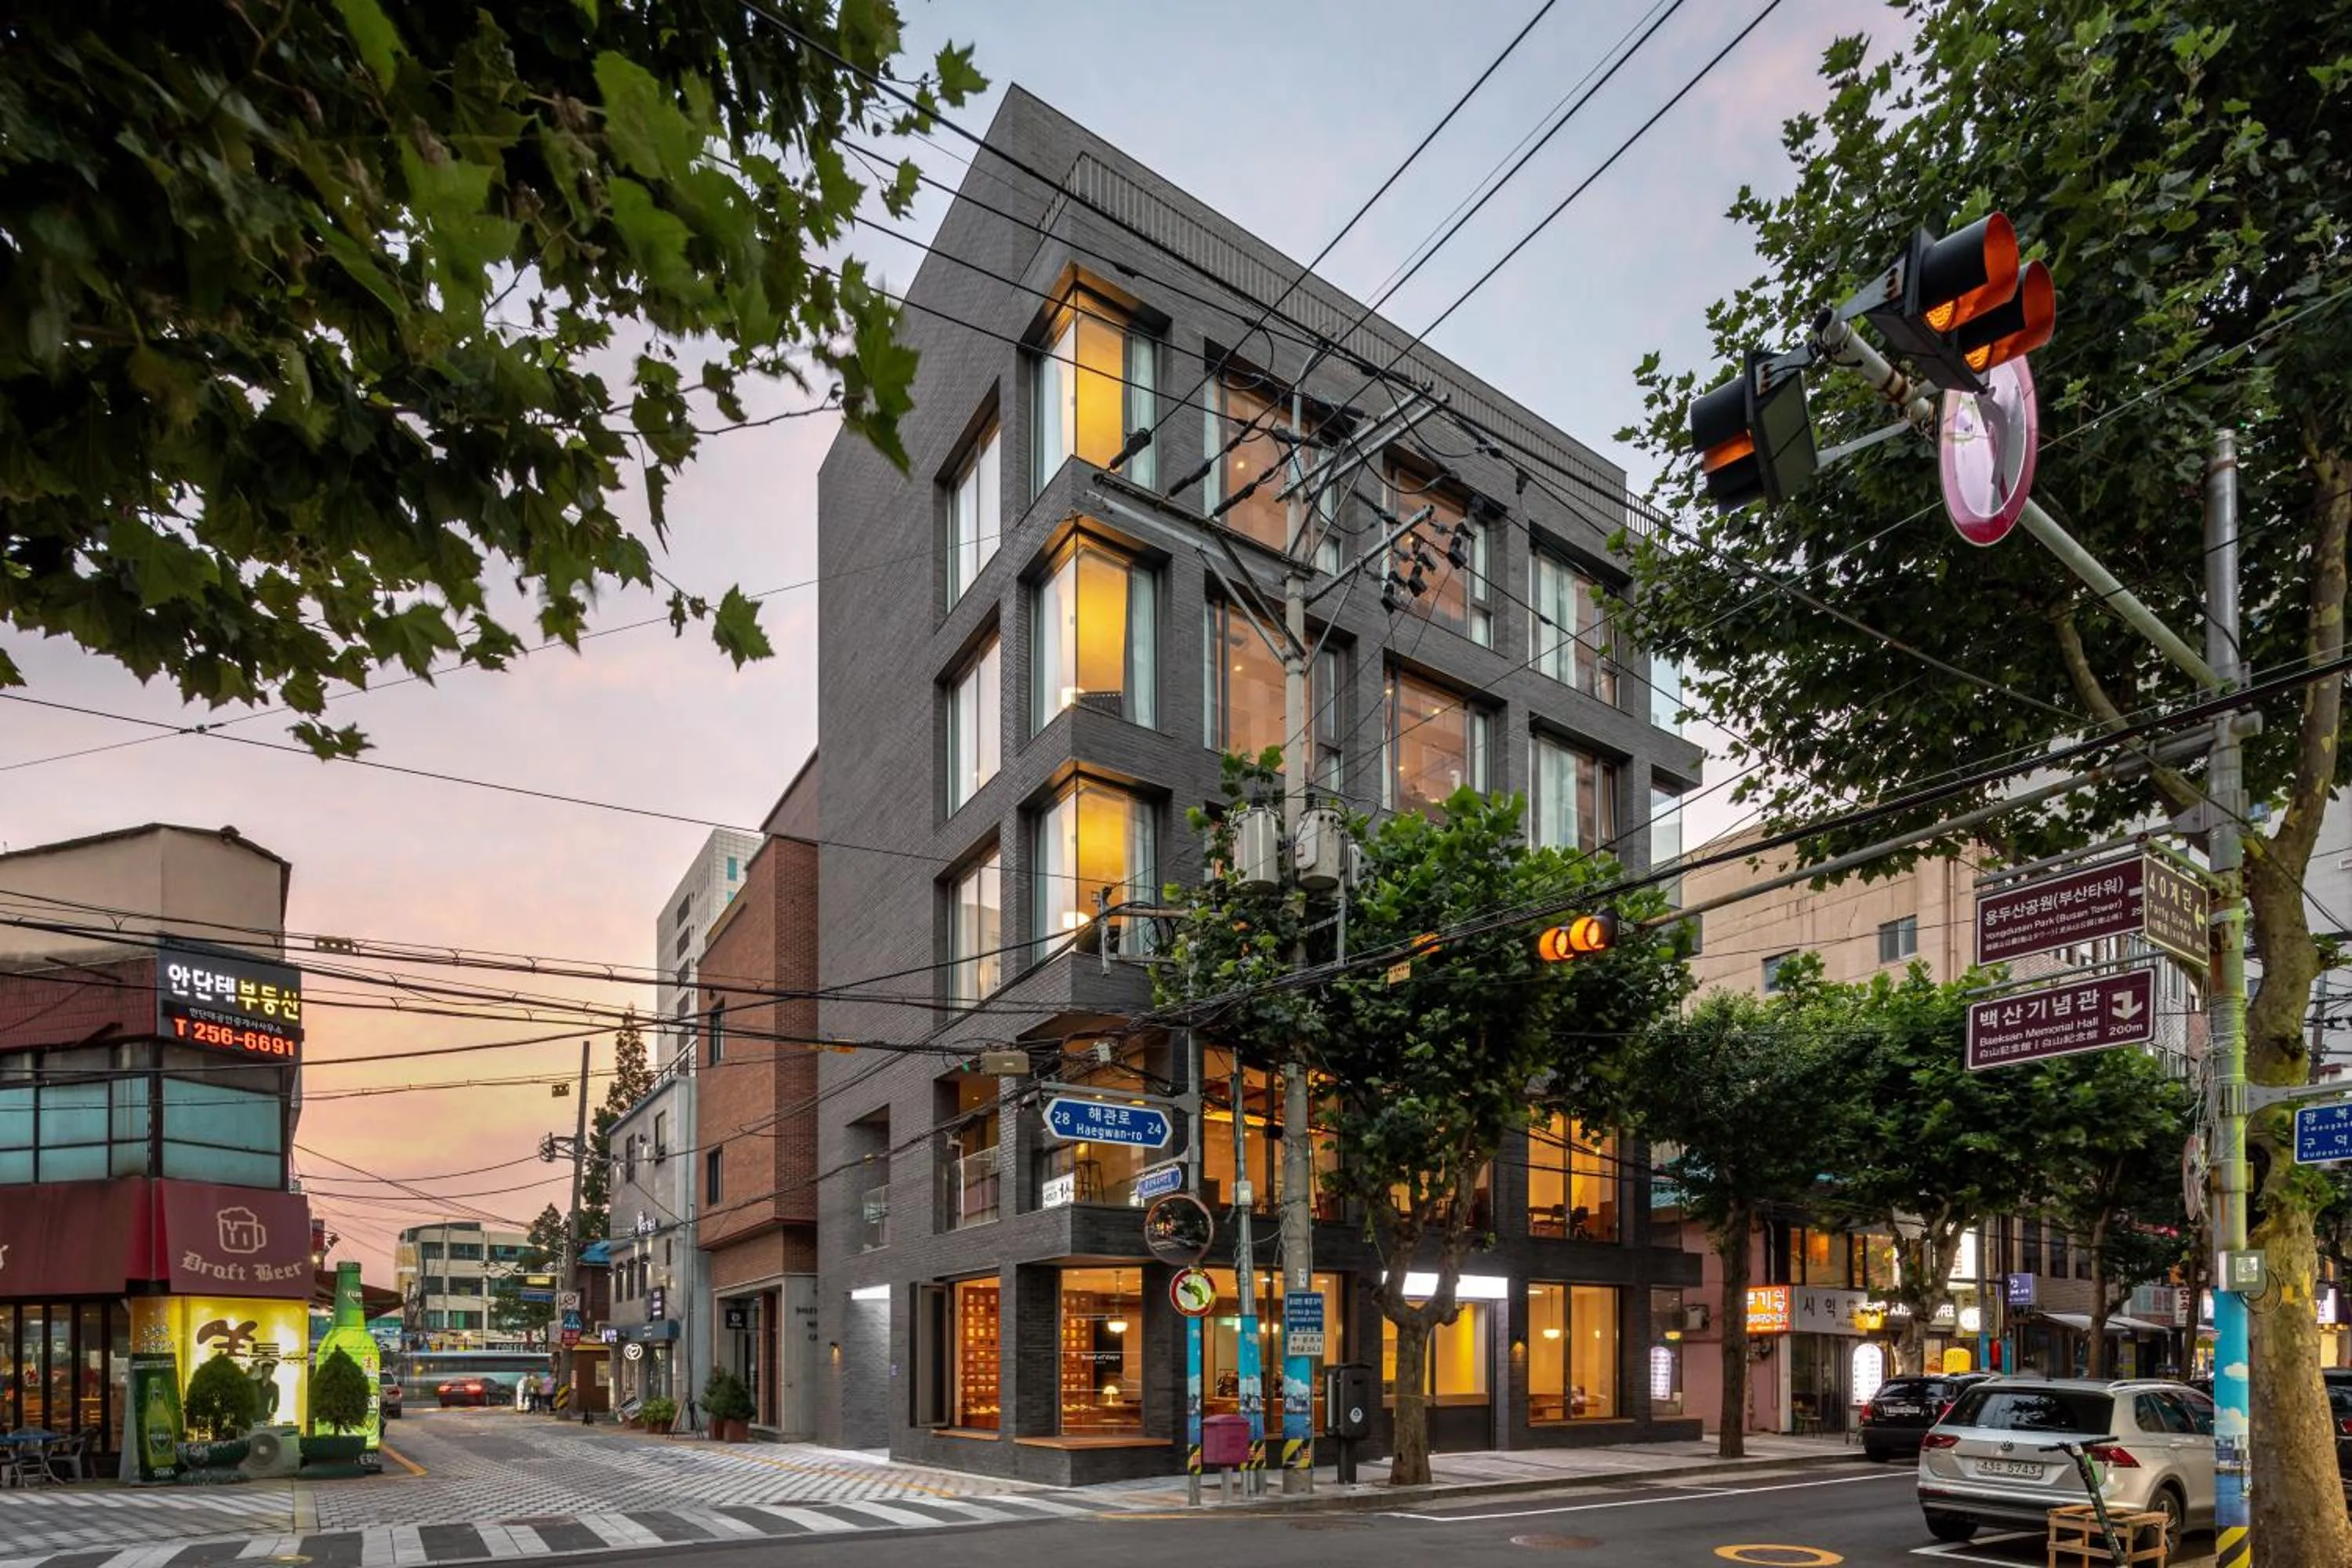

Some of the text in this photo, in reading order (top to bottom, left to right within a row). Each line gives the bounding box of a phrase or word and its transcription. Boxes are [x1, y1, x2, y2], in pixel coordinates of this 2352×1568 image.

[1985, 877, 2124, 926] 용두산공원(부산타워)
[1985, 922, 2033, 941] Yongdusan
[1980, 988, 2100, 1028] 백산기념관
[175, 1018, 295, 1055] T 256-6691
[1980, 1016, 2099, 1047] Baeksan Memorial Hall
[2108, 1023, 2143, 1036] 200m
[1054, 1111, 1070, 1125] 28
[1089, 1106, 1131, 1126] 해관로
[1076, 1123, 1142, 1141] Haegwan-ro
[1147, 1122, 1161, 1135] 24
[181, 1250, 303, 1281] Draft Beer
